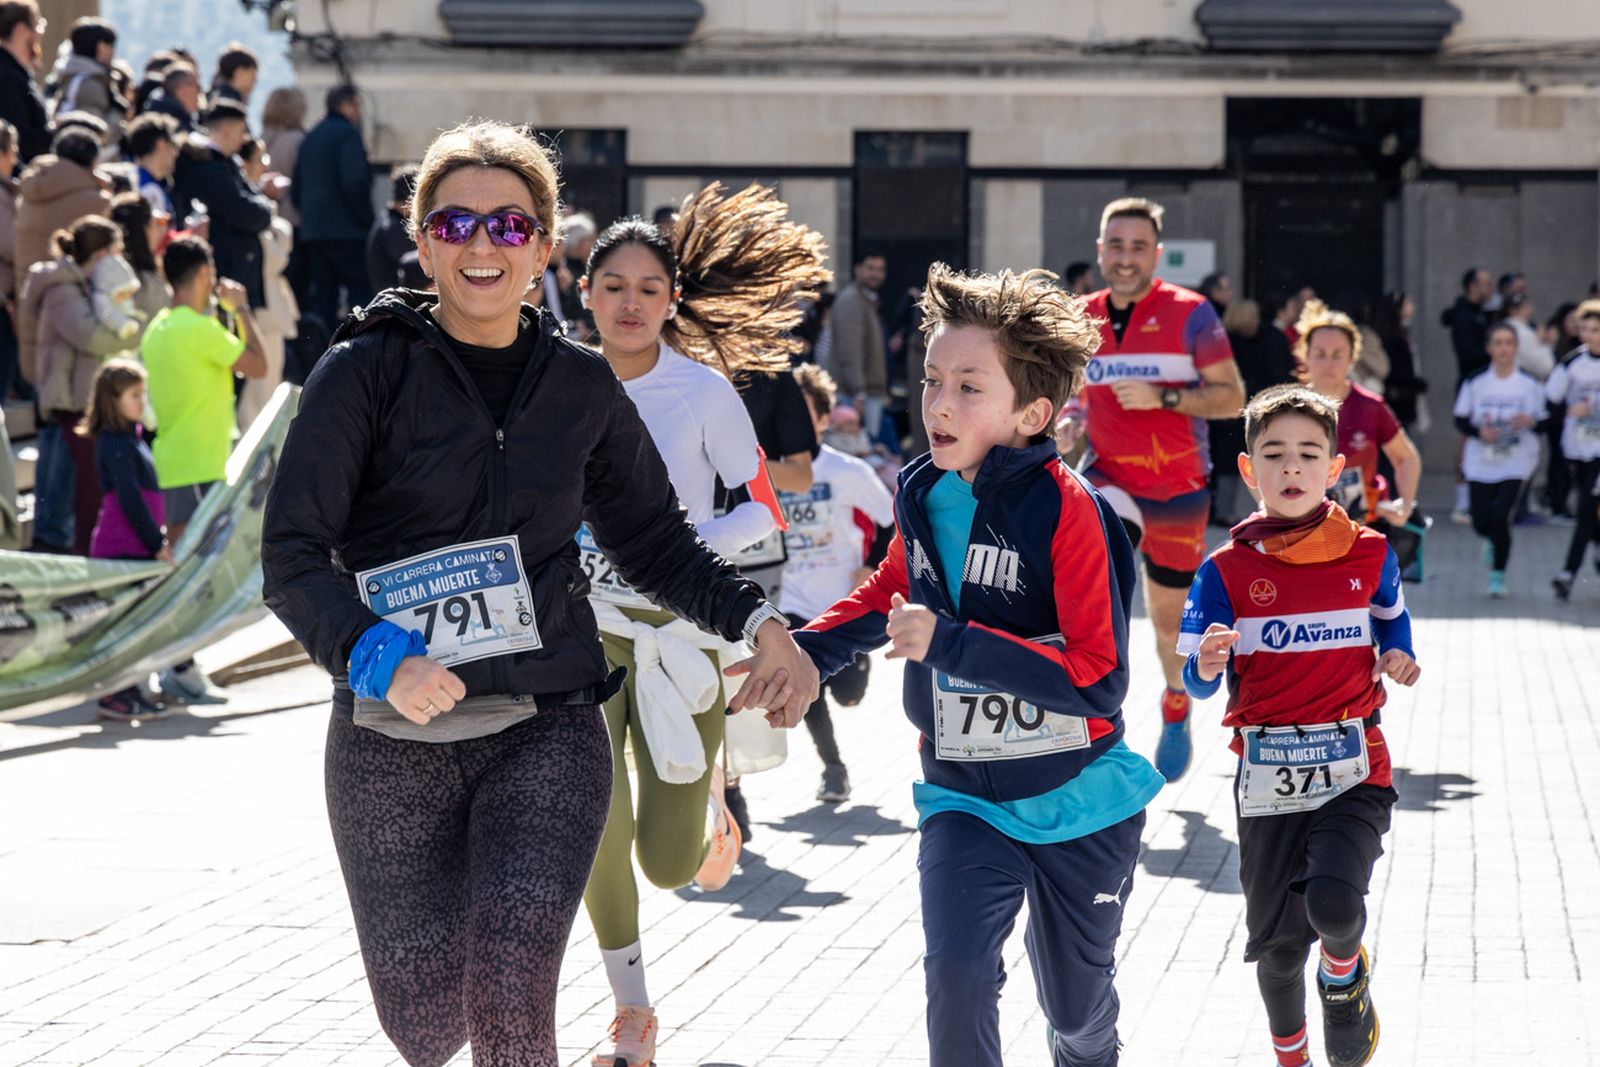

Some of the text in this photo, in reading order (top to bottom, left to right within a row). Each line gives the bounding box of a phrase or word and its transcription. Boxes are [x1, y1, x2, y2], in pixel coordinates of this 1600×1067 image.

[1106, 364, 1160, 377] Avanza
[382, 576, 394, 588] VI
[396, 562, 443, 583] CARRERA
[386, 569, 481, 609] BUENA MUERTE
[413, 592, 492, 646] 791
[1292, 624, 1362, 643] Avanza
[960, 694, 1045, 735] 790
[1266, 735, 1301, 746] CARRERA
[1259, 746, 1328, 762] BUENA MUERTE
[1274, 765, 1332, 797] 371
